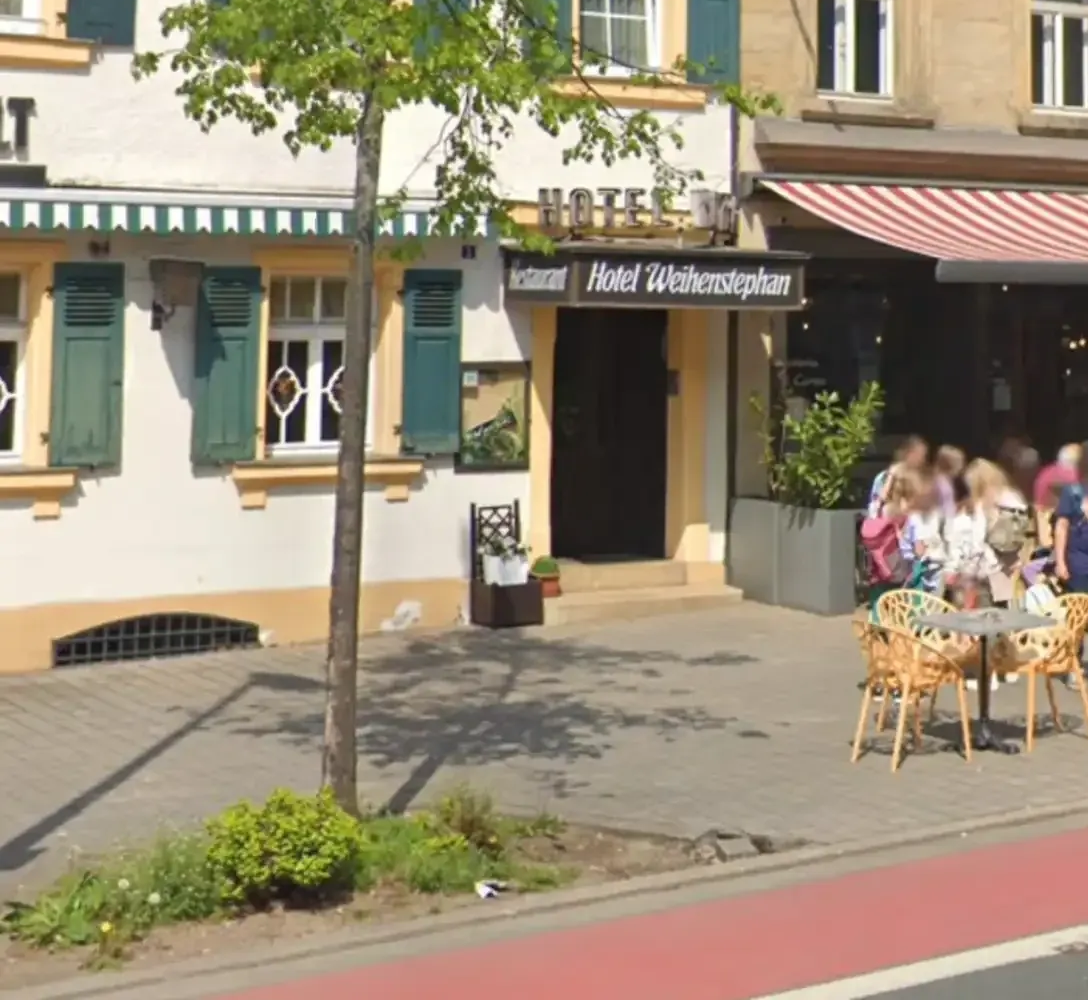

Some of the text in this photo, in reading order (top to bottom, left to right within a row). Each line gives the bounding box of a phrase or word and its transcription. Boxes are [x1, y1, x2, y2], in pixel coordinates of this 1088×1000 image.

[537, 187, 673, 229] HOTEL
[586, 261, 791, 300] Hotel Weihenstephan
